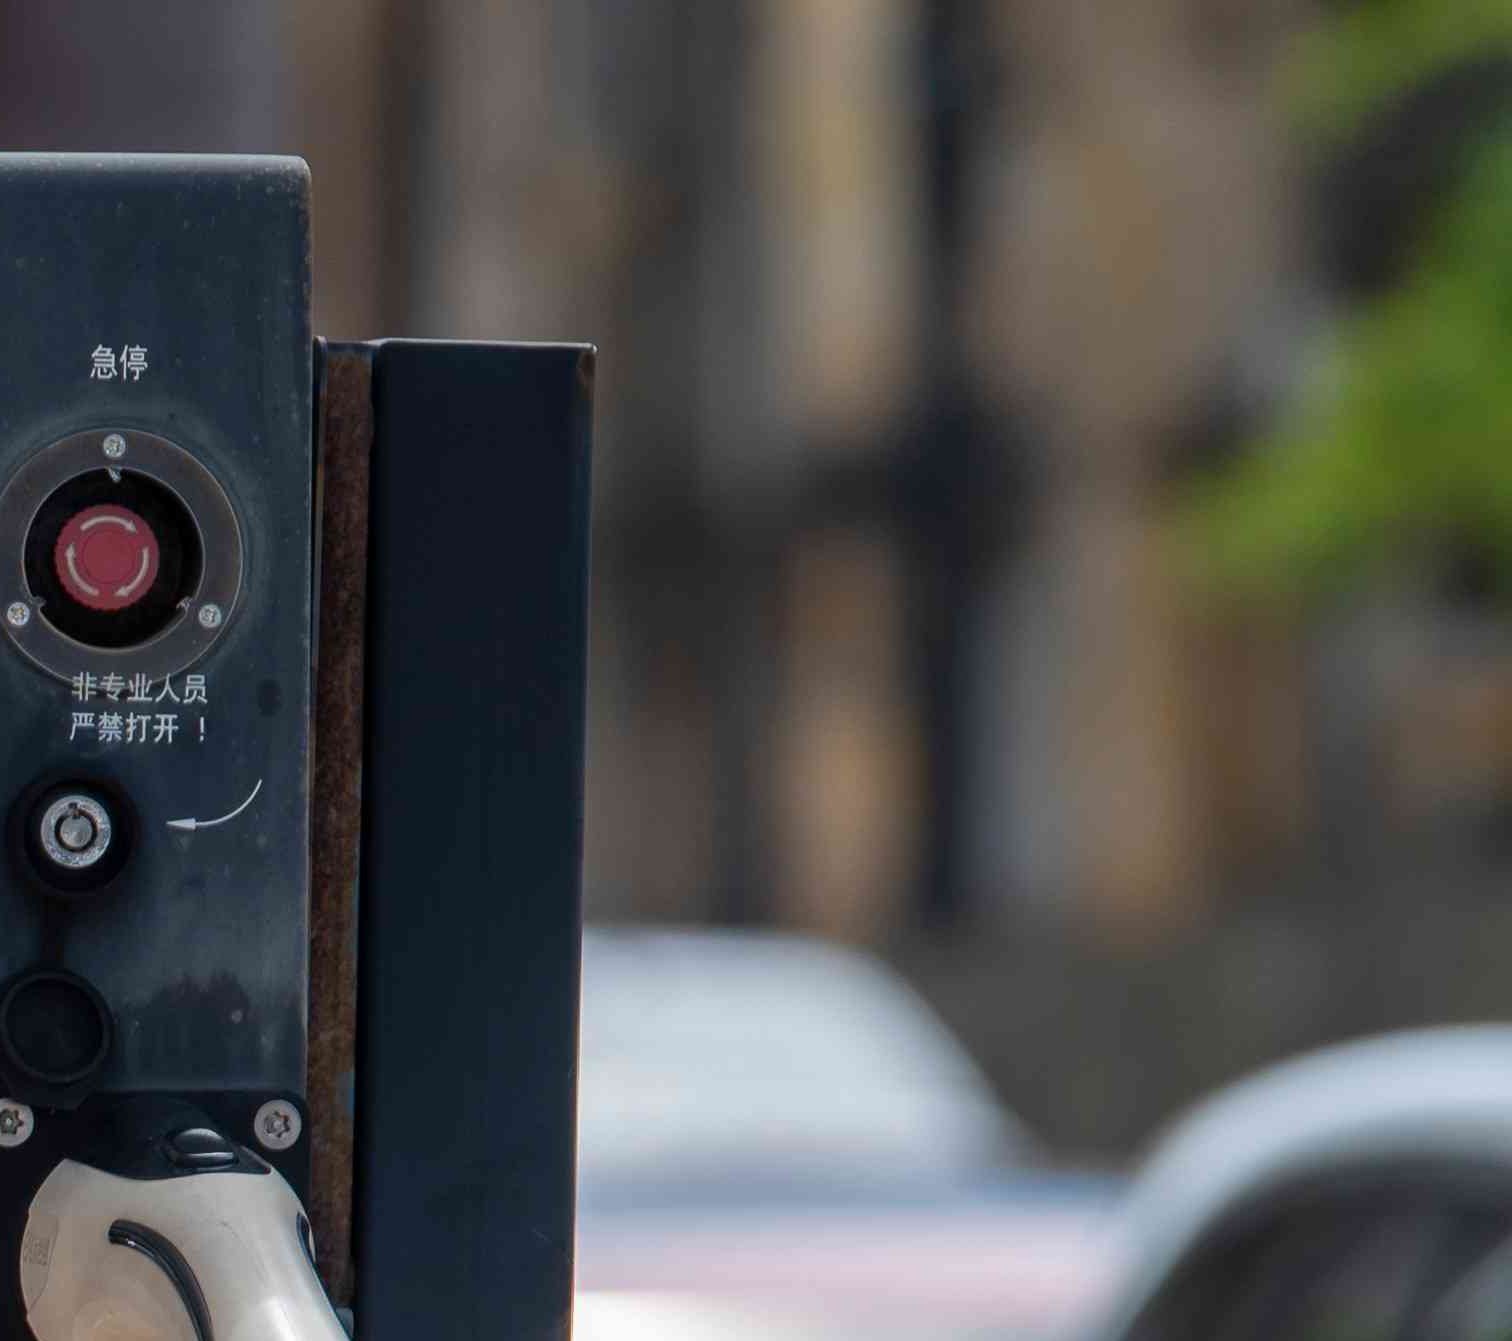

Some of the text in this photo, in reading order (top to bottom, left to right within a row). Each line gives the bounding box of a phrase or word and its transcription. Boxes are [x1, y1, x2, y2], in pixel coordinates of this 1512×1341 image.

[90, 344, 149, 381] 急停
[71, 672, 208, 704] 非专业人员
